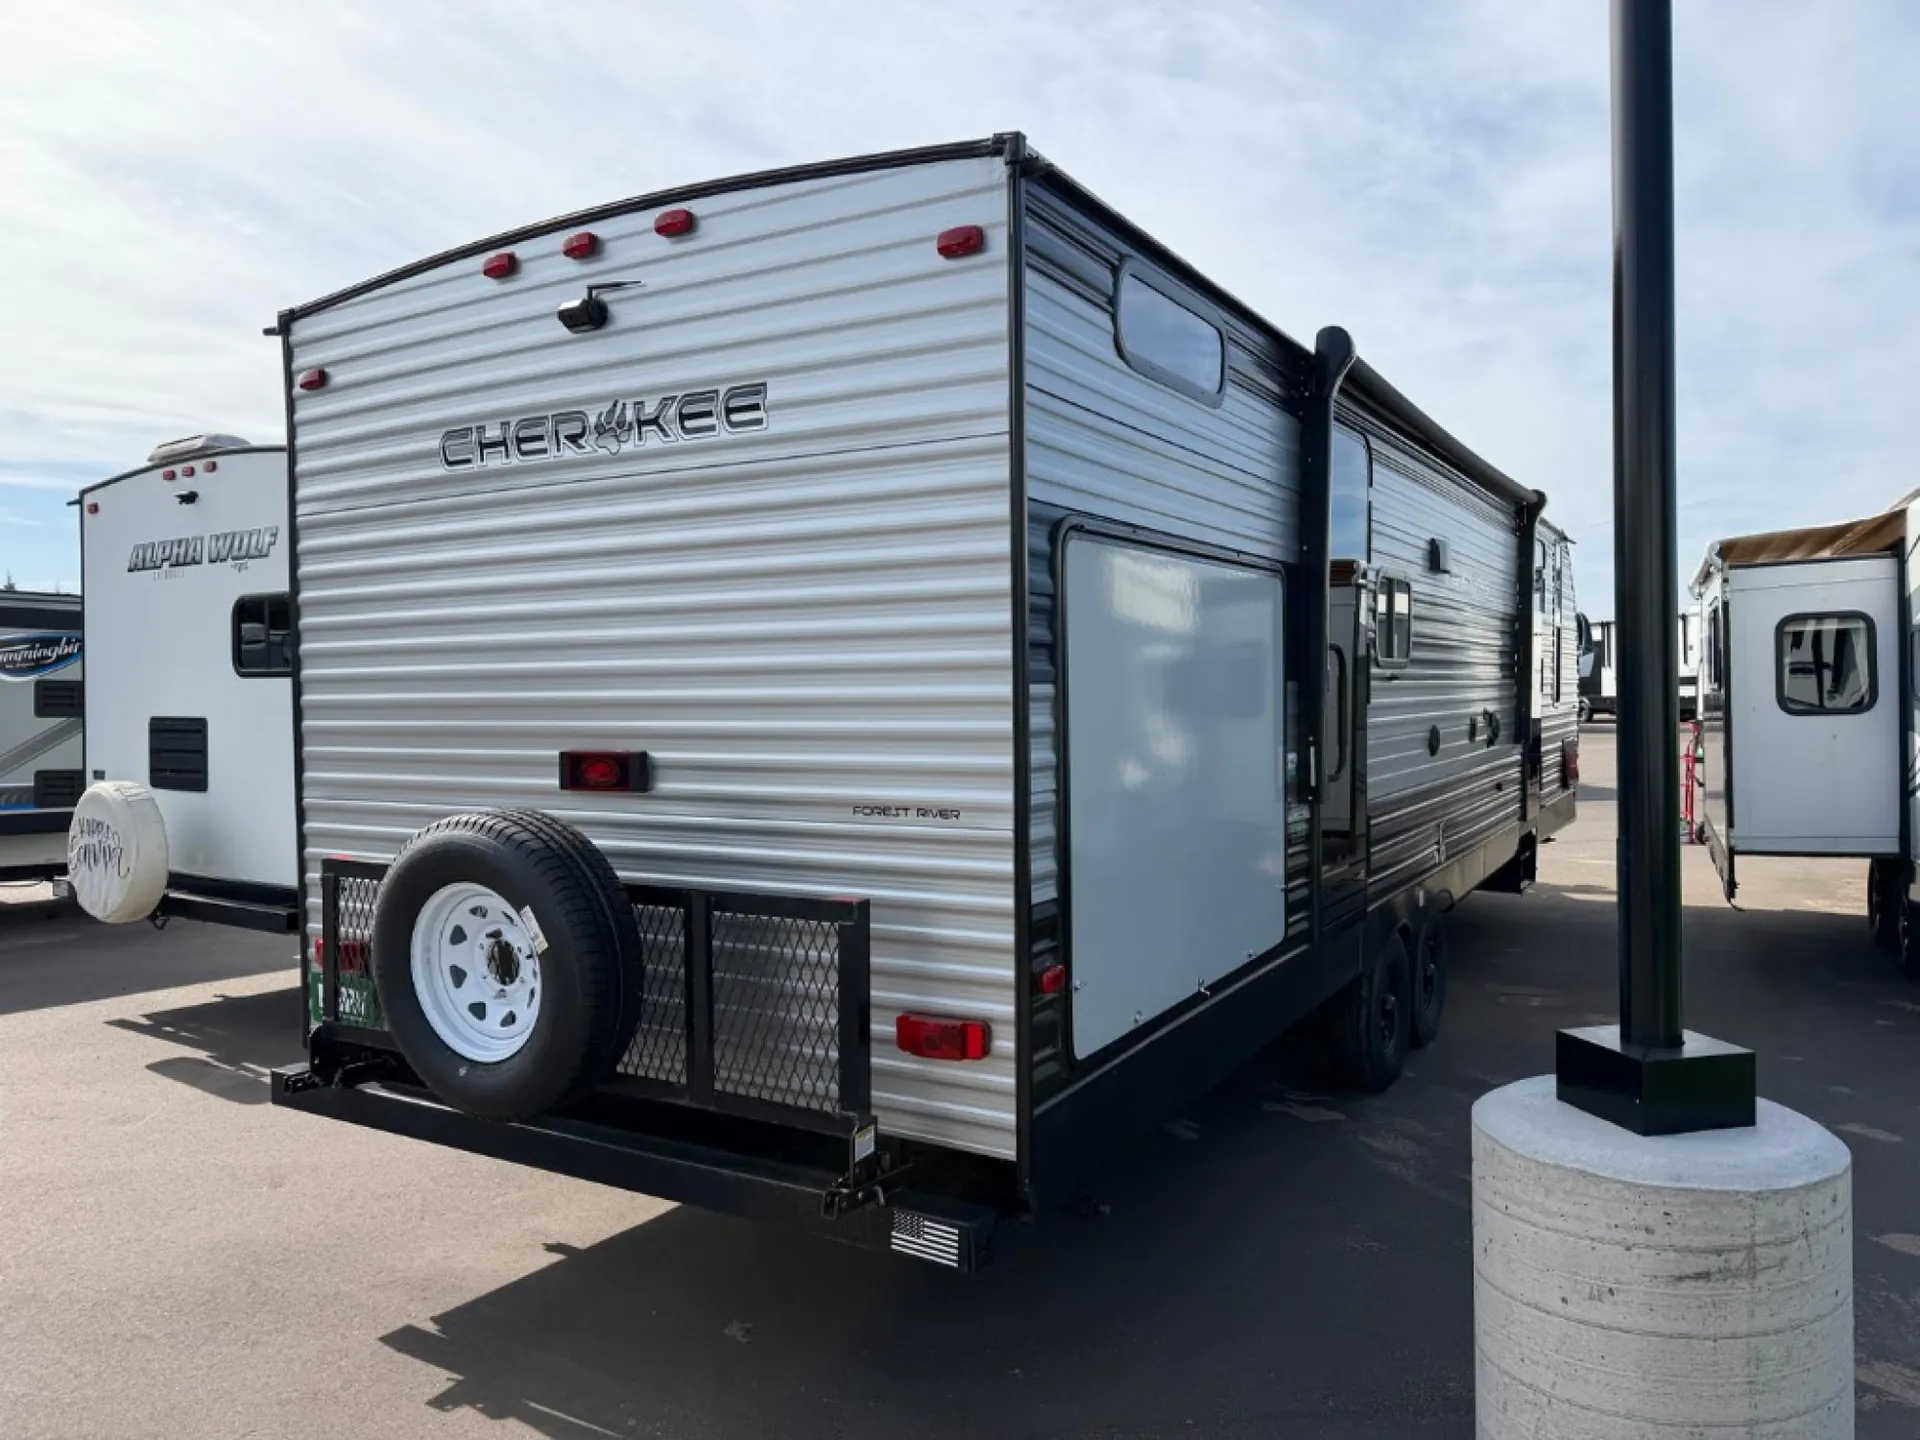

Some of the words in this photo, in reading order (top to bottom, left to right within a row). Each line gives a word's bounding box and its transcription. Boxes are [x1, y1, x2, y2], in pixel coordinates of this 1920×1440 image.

[127, 537, 205, 573] ALPHA
[208, 526, 279, 563] WOLF
[852, 805, 911, 817] FOREST
[916, 807, 960, 820] RIVER
